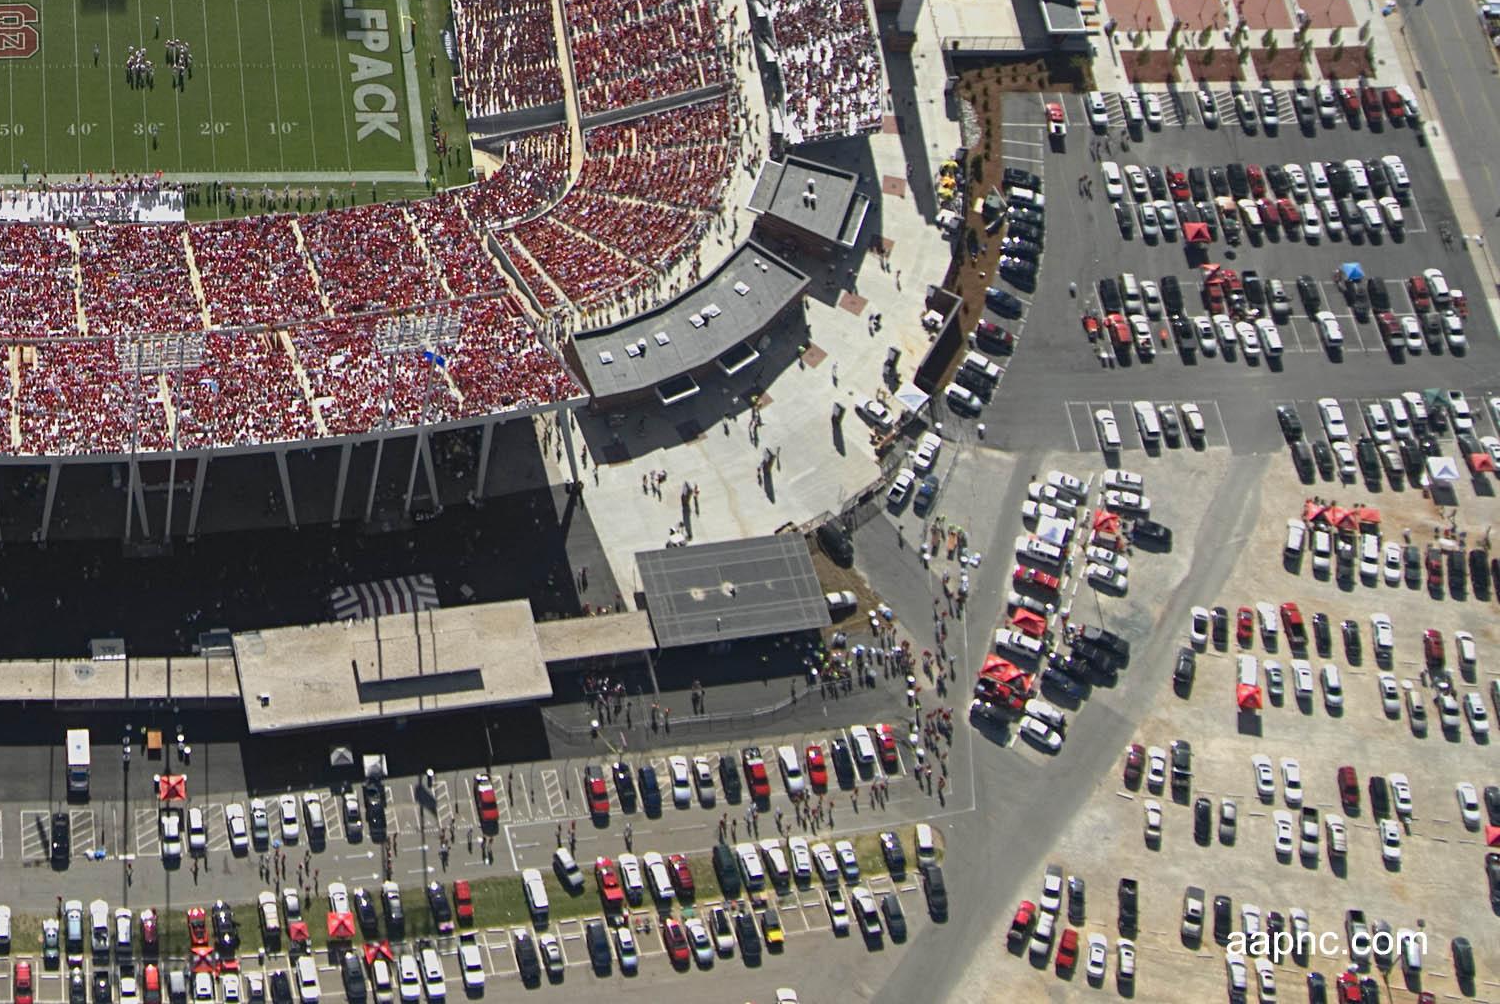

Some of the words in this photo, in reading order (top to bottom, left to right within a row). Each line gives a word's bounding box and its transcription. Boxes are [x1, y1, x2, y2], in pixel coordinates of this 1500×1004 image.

[0, 124, 24, 137] 50
[66, 123, 91, 136] 40
[133, 122, 159, 135] 30
[200, 122, 224, 135] 20
[268, 122, 292, 134] 10
